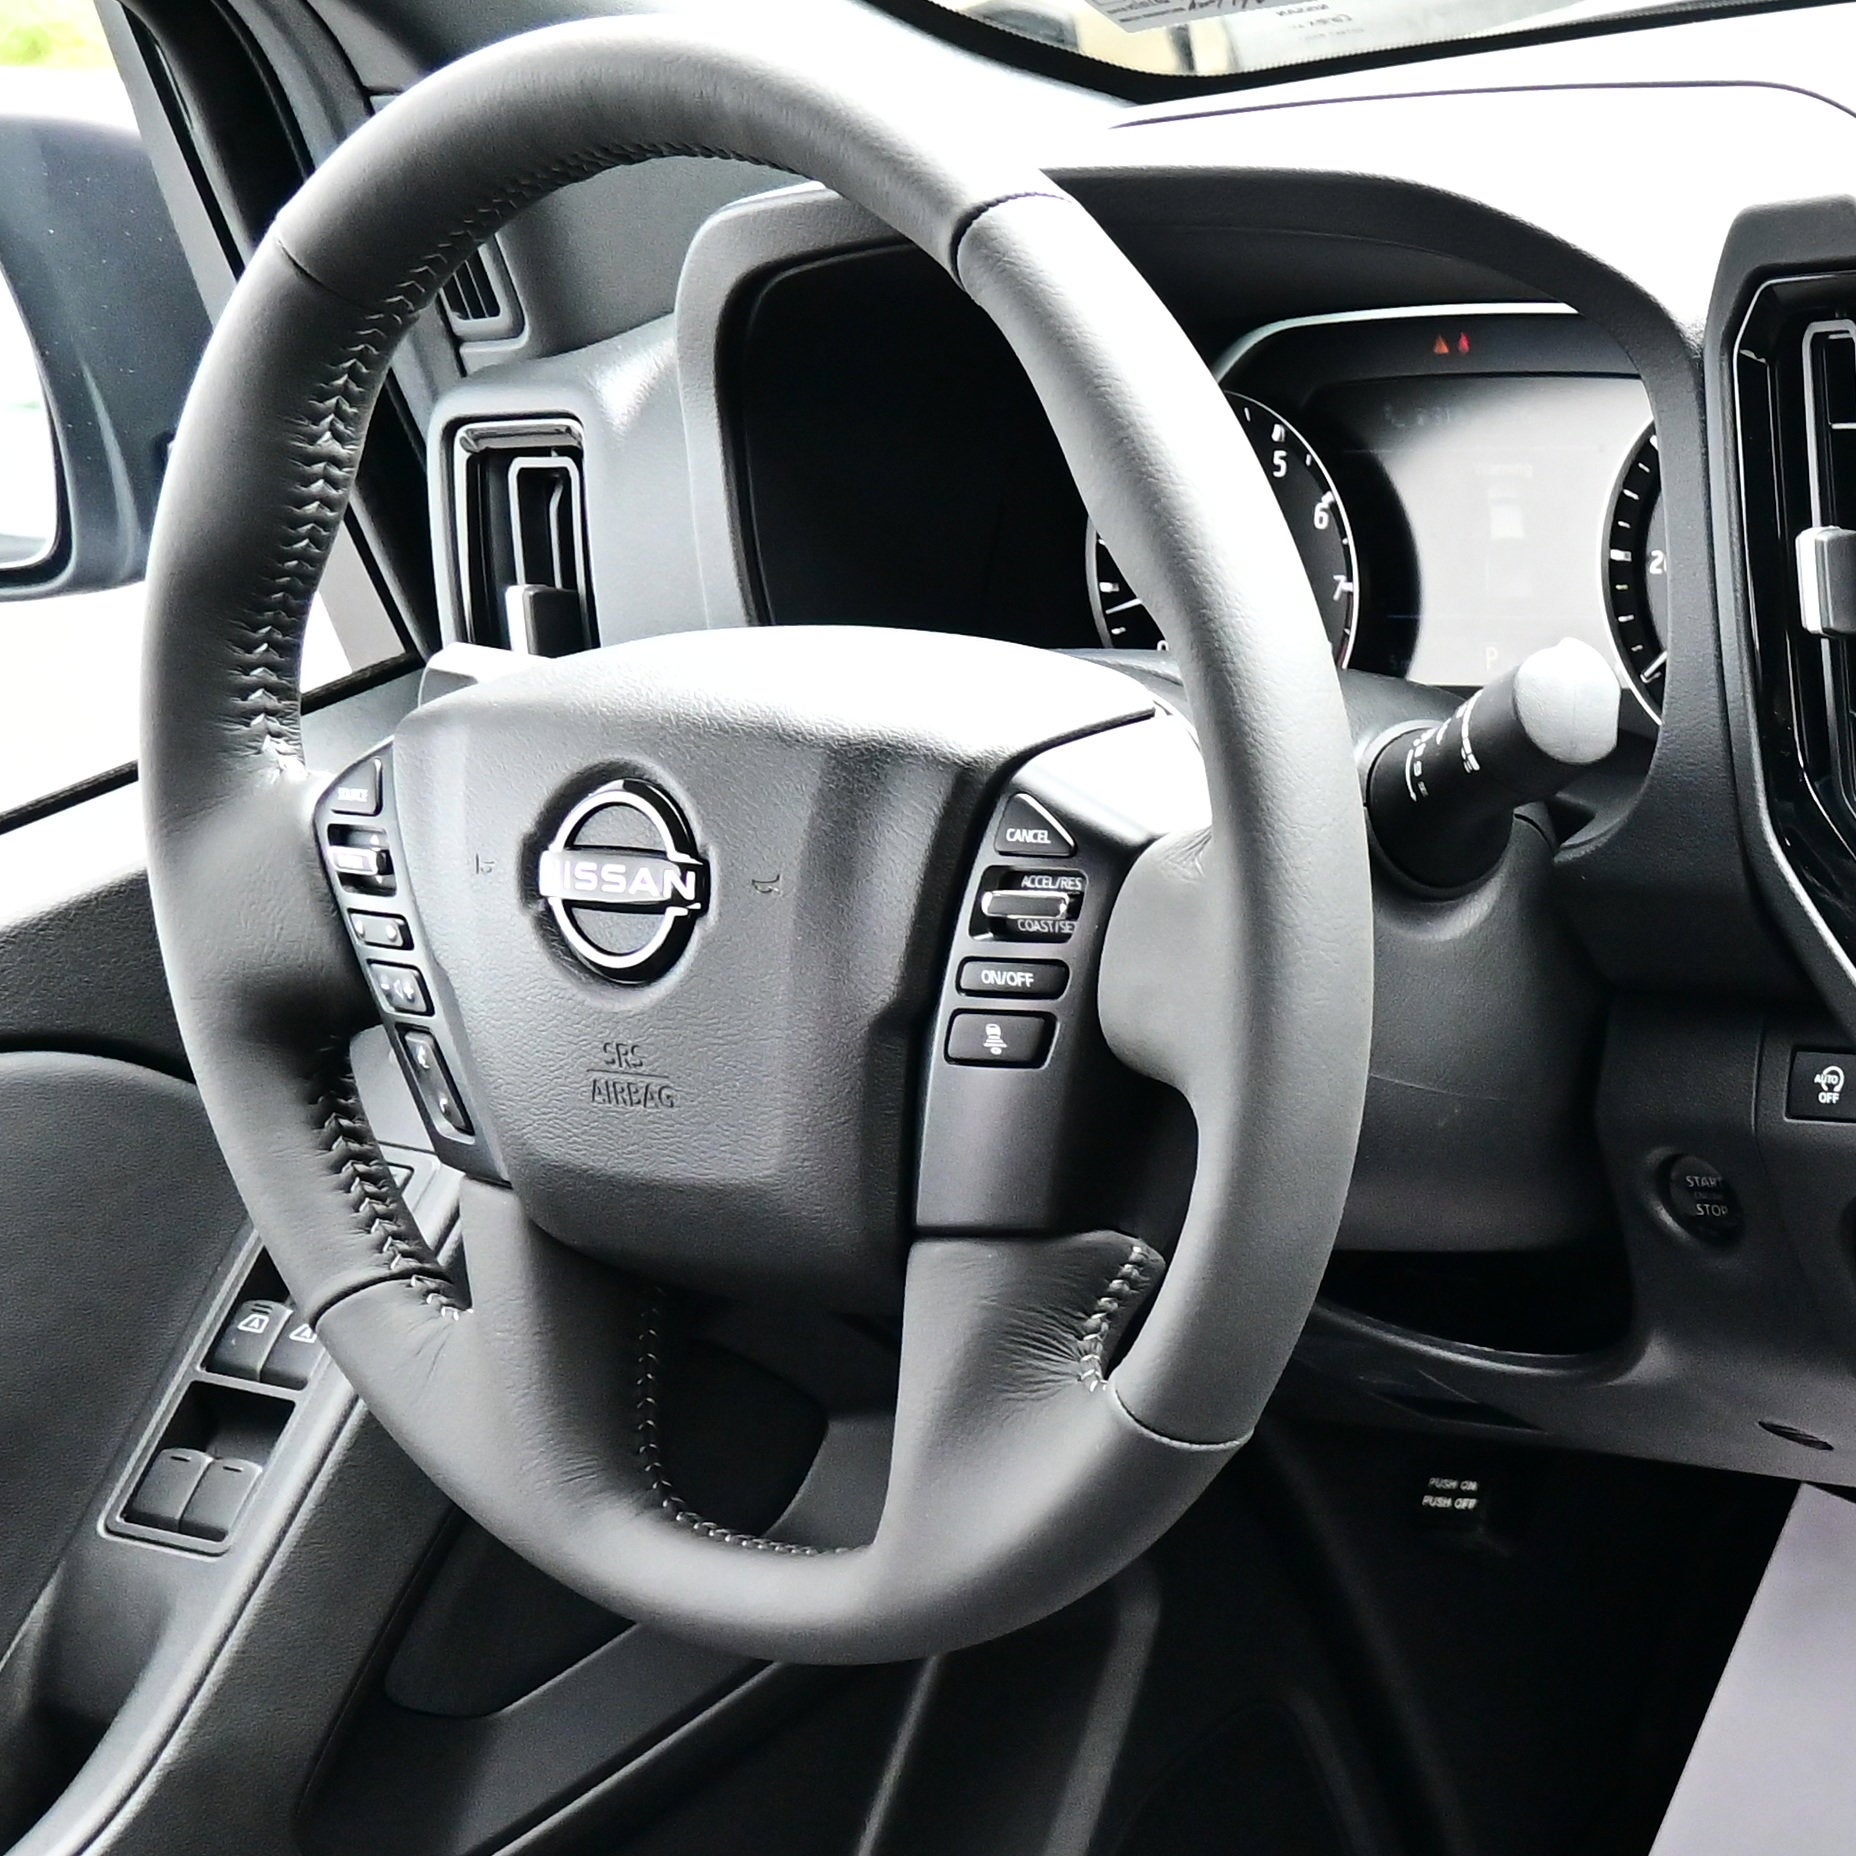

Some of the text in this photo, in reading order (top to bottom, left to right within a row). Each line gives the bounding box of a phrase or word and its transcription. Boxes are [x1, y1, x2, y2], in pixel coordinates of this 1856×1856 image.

[1273, 450, 1288, 479] 5
[1313, 501, 1330, 530] 6
[1333, 574, 1347, 601] 7
[1006, 828, 1051, 844] CANCEL
[1021, 876, 1083, 891] ACCEL/RES
[981, 969, 1034, 988] ON/OFF
[602, 1041, 645, 1070] SRS
[1814, 1073, 1839, 1085] AUTO
[590, 1077, 675, 1109] AIRBAG
[1818, 1092, 1840, 1104] OFF
[1695, 1203, 1729, 1217] STOP
[1421, 1494, 1452, 1508] PUSH
